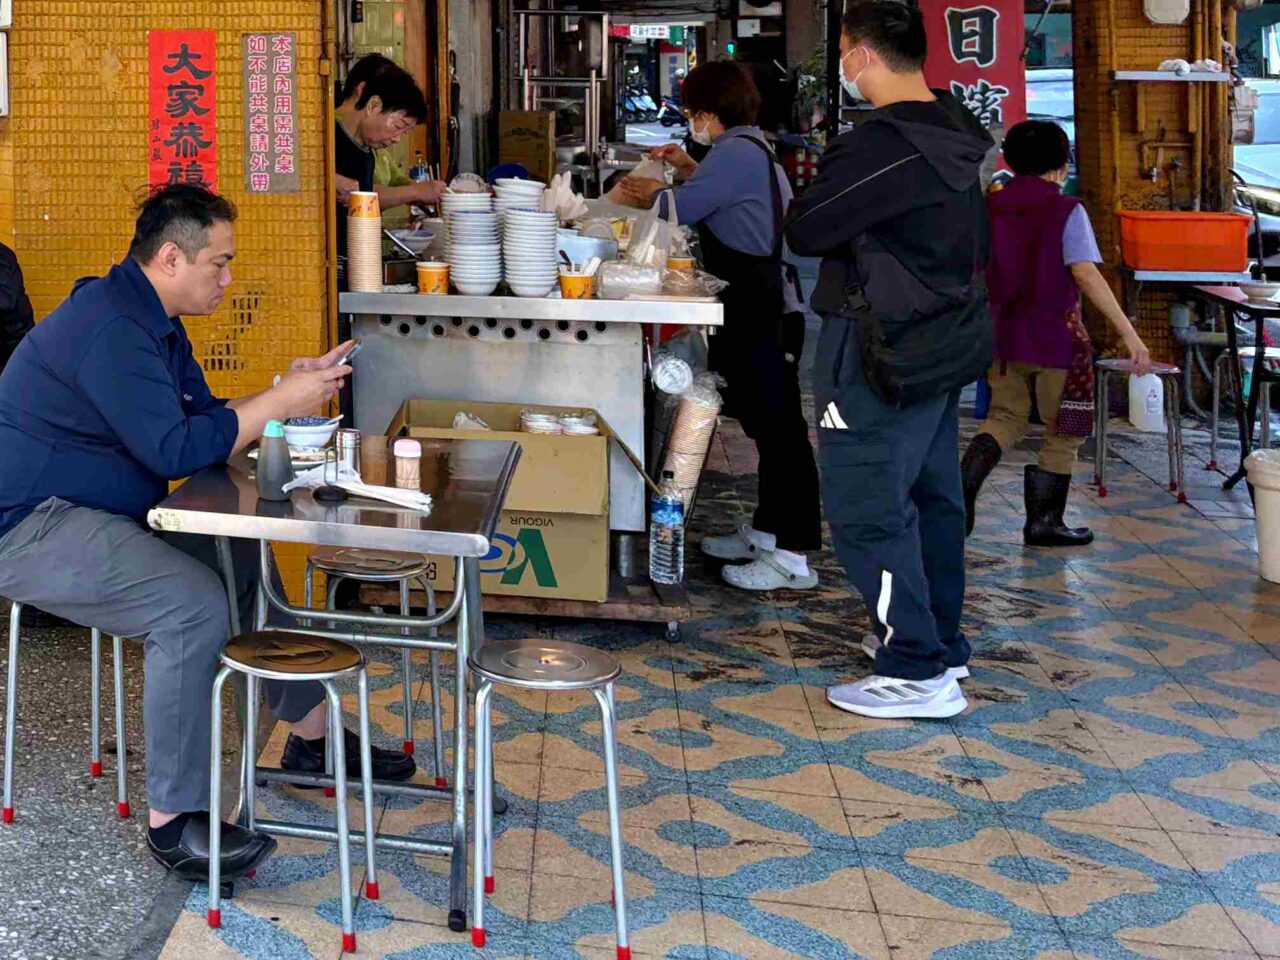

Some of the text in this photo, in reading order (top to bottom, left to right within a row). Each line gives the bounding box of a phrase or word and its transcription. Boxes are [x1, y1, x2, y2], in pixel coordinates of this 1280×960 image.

[248, 35, 270, 192] 如不能共桌請外帶
[272, 35, 294, 174] 本店內用需共桌
[510, 516, 554, 527] VIGOUR
